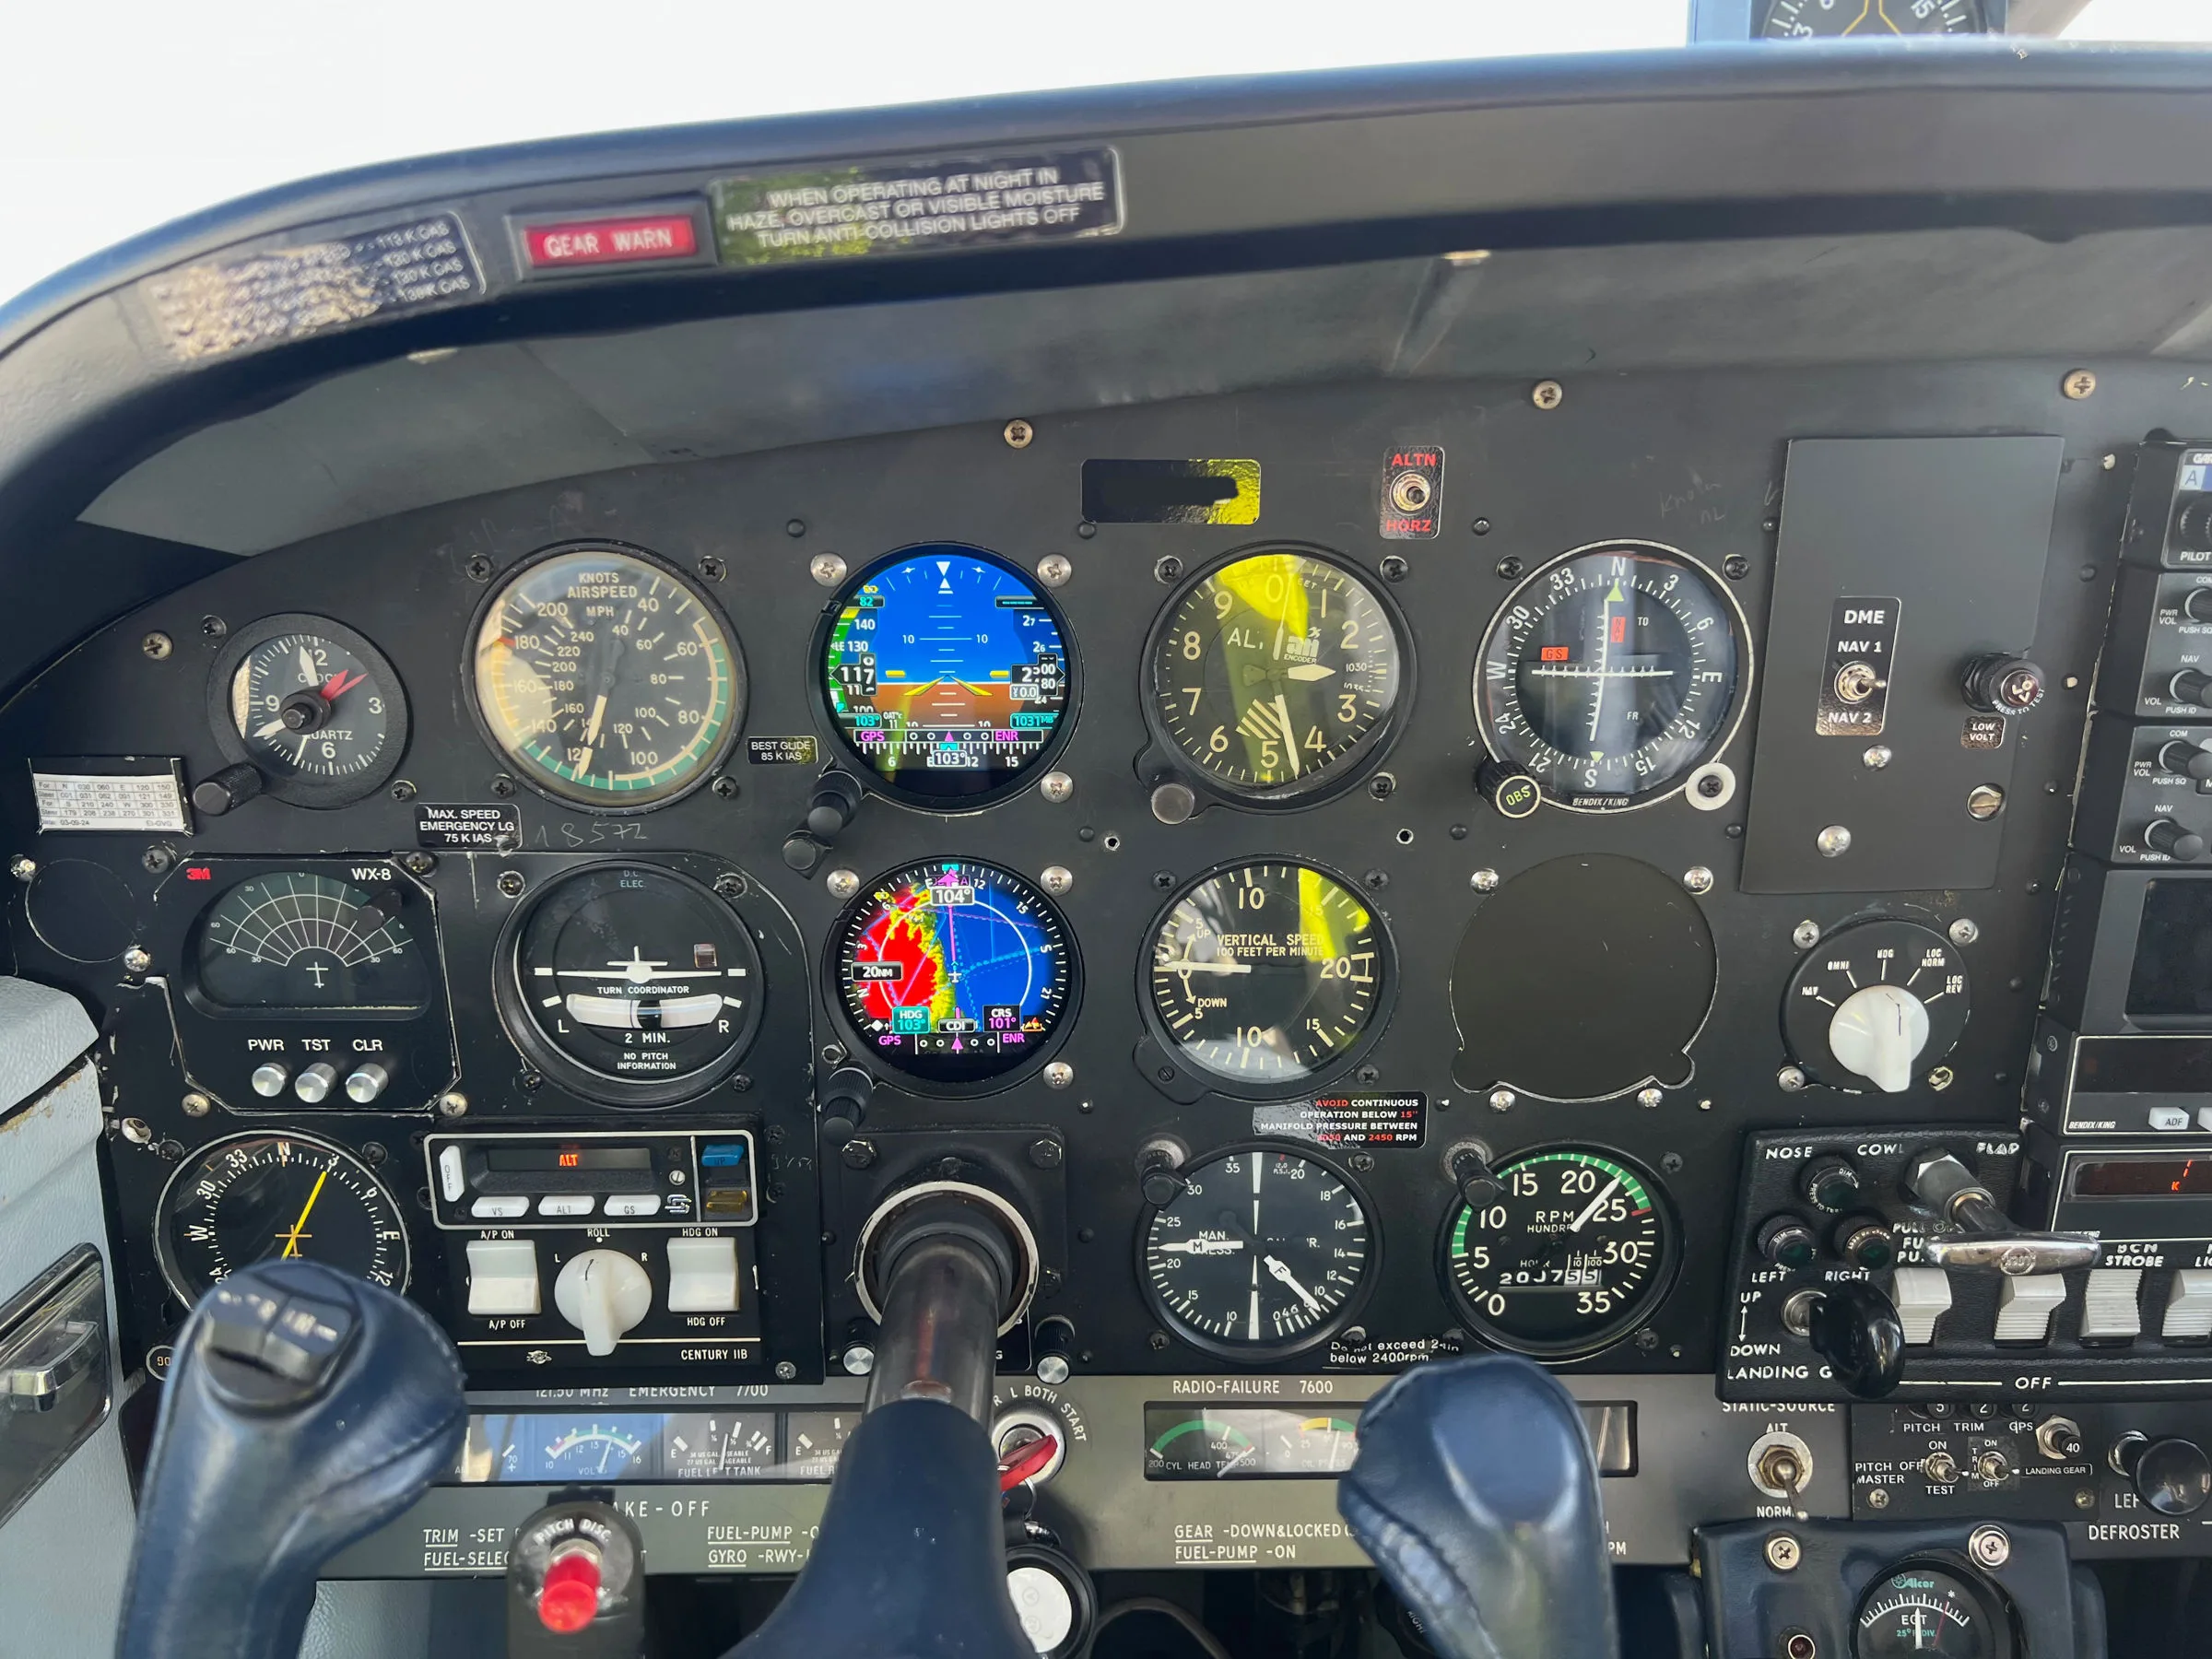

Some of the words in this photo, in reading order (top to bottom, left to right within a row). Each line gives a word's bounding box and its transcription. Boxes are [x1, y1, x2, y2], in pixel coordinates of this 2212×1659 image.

[767, 188, 829, 208] WHEN
[831, 176, 941, 203] OPERATING
[945, 173, 971, 192] AT
[973, 170, 1033, 191] NIGHT
[785, 201, 891, 227] OVERCAST
[894, 201, 924, 218] OR
[927, 193, 1001, 217] VISIBLE
[1004, 182, 1104, 208] MOISTURE
[758, 227, 810, 248] TURN
[811, 215, 971, 244] ANTI-COLLISION
[972, 208, 1040, 231] LIGHTS
[1042, 202, 1081, 223] OFF
[543, 232, 599, 257] GEAR
[610, 228, 672, 253] WARN
[1392, 453, 1437, 467] ALTN
[1386, 519, 1431, 533] HORZ
[579, 572, 619, 583] KNOTS
[567, 586, 638, 598] AIRSPEED
[1265, 574, 1284, 603] 0
[537, 603, 568, 617] 200
[1214, 591, 1233, 619] 9
[586, 606, 615, 617] MPH
[1843, 609, 1885, 624] DME
[1637, 617, 1649, 627] TO
[514, 636, 540, 649] 180
[902, 634, 915, 644] 10
[976, 634, 988, 644] 10
[1182, 631, 1201, 660] 8
[1837, 641, 1869, 653] NAV
[1283, 653, 1317, 664] ENCODER
[552, 662, 576, 672] 200
[1627, 711, 1640, 721] FR
[1828, 712, 1859, 724] NAV
[1972, 723, 1994, 731] LOW
[861, 731, 885, 742] GPS
[995, 731, 1018, 741] ENR
[1970, 733, 1995, 741] VOLT
[751, 741, 778, 750] BEST
[780, 741, 811, 750] GLIDE
[760, 752, 773, 760] 85
[785, 751, 803, 761] IAS
[1504, 787, 1532, 806] OBS
[1571, 796, 1630, 807] BENDIX/KING
[428, 808, 458, 819] MAX.
[461, 808, 500, 819] SPEED
[419, 820, 496, 831] EMERGENCY
[498, 820, 515, 831] LG
[444, 833, 459, 843] 75
[472, 833, 493, 843] IAS
[351, 867, 392, 880] WX-8
[620, 879, 644, 888] ELEC
[1217, 934, 1277, 947] VERTICAL
[1286, 934, 1324, 947] SPEED
[1237, 947, 1262, 957] FEET
[1265, 947, 1287, 957] PER
[1289, 947, 1324, 958] MINUTE
[1926, 948, 1943, 959] LOC
[1922, 958, 1946, 967] NORM
[1947, 975, 1963, 985] LOC
[597, 986, 622, 994] TURN
[628, 985, 689, 994] COORDINATOR
[1802, 986, 1818, 995] NAV
[1946, 984, 1963, 994] REV
[1197, 997, 1228, 1007] DOWN
[900, 1009, 923, 1019] HDG
[991, 1008, 1012, 1018] CRS
[946, 1021, 965, 1031] CDI
[641, 1033, 670, 1043] MIN.
[878, 1035, 901, 1046] GPS
[1003, 1032, 1025, 1044] ENR
[247, 1039, 285, 1051] PWR
[301, 1039, 331, 1051] TST
[352, 1039, 383, 1052] CLR
[641, 1053, 669, 1061] PITCH
[617, 1062, 677, 1070] INFORMATION
[1351, 1099, 1418, 1107] CONTINUOUS
[1300, 1111, 1359, 1119] OPERATION
[2068, 1120, 2116, 1130] BENDIX/KING
[2164, 1116, 2183, 1126] ADF
[1765, 1146, 1813, 1159] NOSE
[1976, 1142, 2020, 1155] FLAP
[559, 1154, 578, 1166] ALT
[1535, 1210, 1574, 1222] RPM
[480, 1230, 499, 1240] A/P
[501, 1229, 514, 1239] ON
[587, 1228, 610, 1237] ROLL
[682, 1227, 701, 1237] HDG
[705, 1227, 718, 1237] ON
[1198, 1231, 1229, 1241] MAN.
[2105, 1255, 2164, 1267] STROBE
[1751, 1271, 1787, 1284] LEFT
[1824, 1271, 1871, 1282] RIGHT
[1740, 1291, 1762, 1303] UP
[488, 1319, 507, 1329] A/P
[510, 1319, 525, 1329] OFF
[687, 1317, 706, 1326] HDG
[709, 1316, 725, 1326] OFF
[1377, 1339, 1425, 1351] exceed
[680, 1348, 728, 1360] CENTURY
[733, 1348, 748, 1359] IIB
[1730, 1344, 1781, 1358] DOWN
[1330, 1353, 1367, 1364] below
[1727, 1366, 1809, 1380] LANDING
[1172, 1380, 1280, 1394] RADIO-FAILURE
[1300, 1380, 1334, 1394] 7600
[2015, 1377, 2053, 1389] OFF
[629, 1385, 716, 1398] EMERGENCY
[993, 1394, 1003, 1406] R
[1024, 1385, 1058, 1404] BOTH
[1061, 1403, 1087, 1441] START
[1903, 1423, 1940, 1432] PITCH
[1954, 1422, 1984, 1432] TRIM
[2009, 1422, 2033, 1431] GPS
[1929, 1441, 1947, 1450] ON
[1166, 1462, 1182, 1470] CYL
[1187, 1461, 1211, 1470] HEAD
[1855, 1463, 1892, 1472] PITCH
[1900, 1462, 1924, 1471] OFF
[2026, 1466, 2062, 1475] LANDING
[2064, 1465, 2086, 1475] GEAR
[733, 1466, 761, 1477] TANK
[1856, 1475, 1905, 1485] MASTER
[1983, 1479, 1999, 1488] OFF
[1925, 1485, 1955, 1495] TEST
[423, 1528, 459, 1544] TRIM
[469, 1527, 506, 1543] -SET
[534, 1518, 575, 1546] PITCH
[707, 1525, 793, 1540] FUEL-PUMP
[1174, 1524, 1213, 1538] GEAR
[1223, 1524, 1341, 1538] -DOWN&LOCKED
[2088, 1524, 2180, 1540] DEFROSTER
[708, 1549, 747, 1564] GYRO
[1175, 1545, 1257, 1559] FUEL-PUMP
